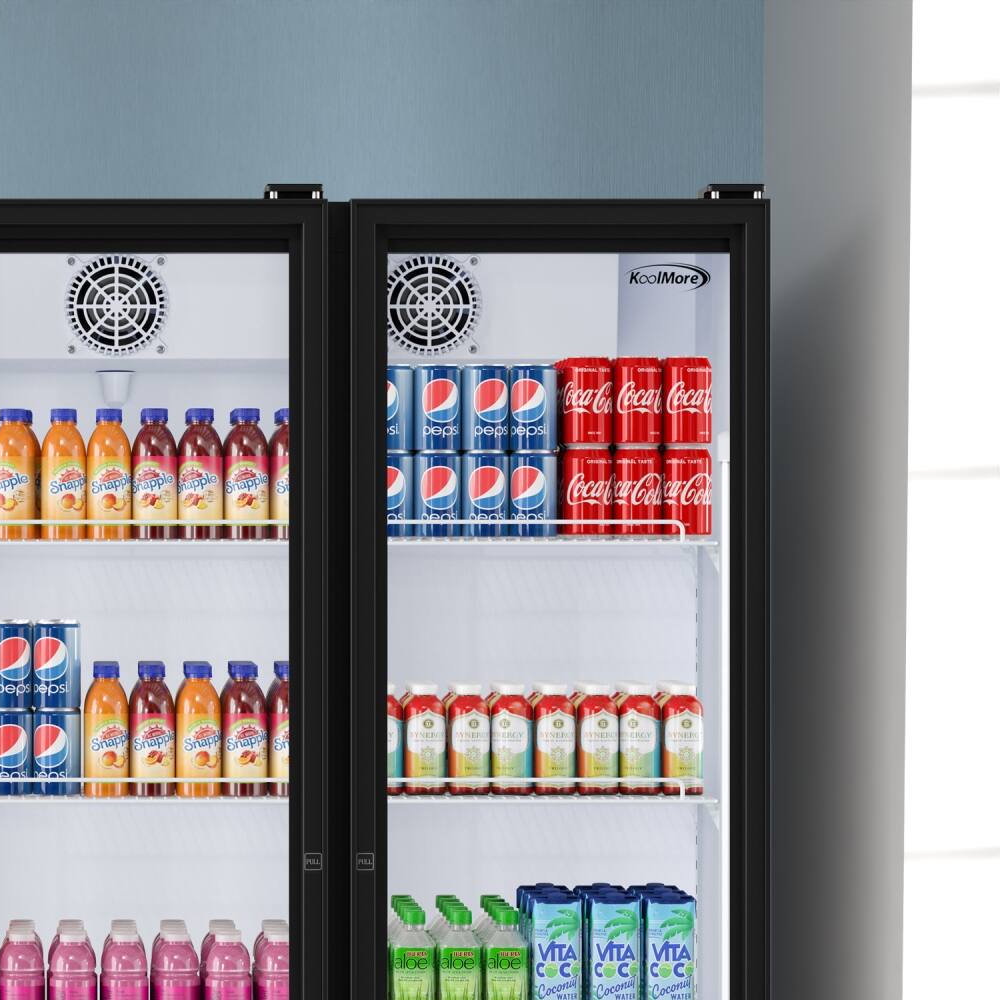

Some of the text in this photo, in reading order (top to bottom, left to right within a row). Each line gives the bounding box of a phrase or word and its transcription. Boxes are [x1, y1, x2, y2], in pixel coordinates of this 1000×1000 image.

[630, 271, 699, 284] KoolMore
[423, 424, 459, 438] pepsi
[132, 473, 174, 494] Snapple
[225, 473, 269, 494] Snapple
[538, 941, 577, 961] VITA
[596, 941, 635, 961] VITA
[652, 941, 691, 961] VITA
[394, 954, 428, 970] aloe
[441, 954, 475, 970] aloe
[487, 954, 521, 970] aloe
[536, 962, 580, 978] COCO
[594, 962, 638, 978] COCO
[650, 962, 694, 978] COCO
[538, 975, 577, 1000] Coconut
[596, 975, 635, 1000] Coconut
[652, 975, 692, 1000] Coconut
